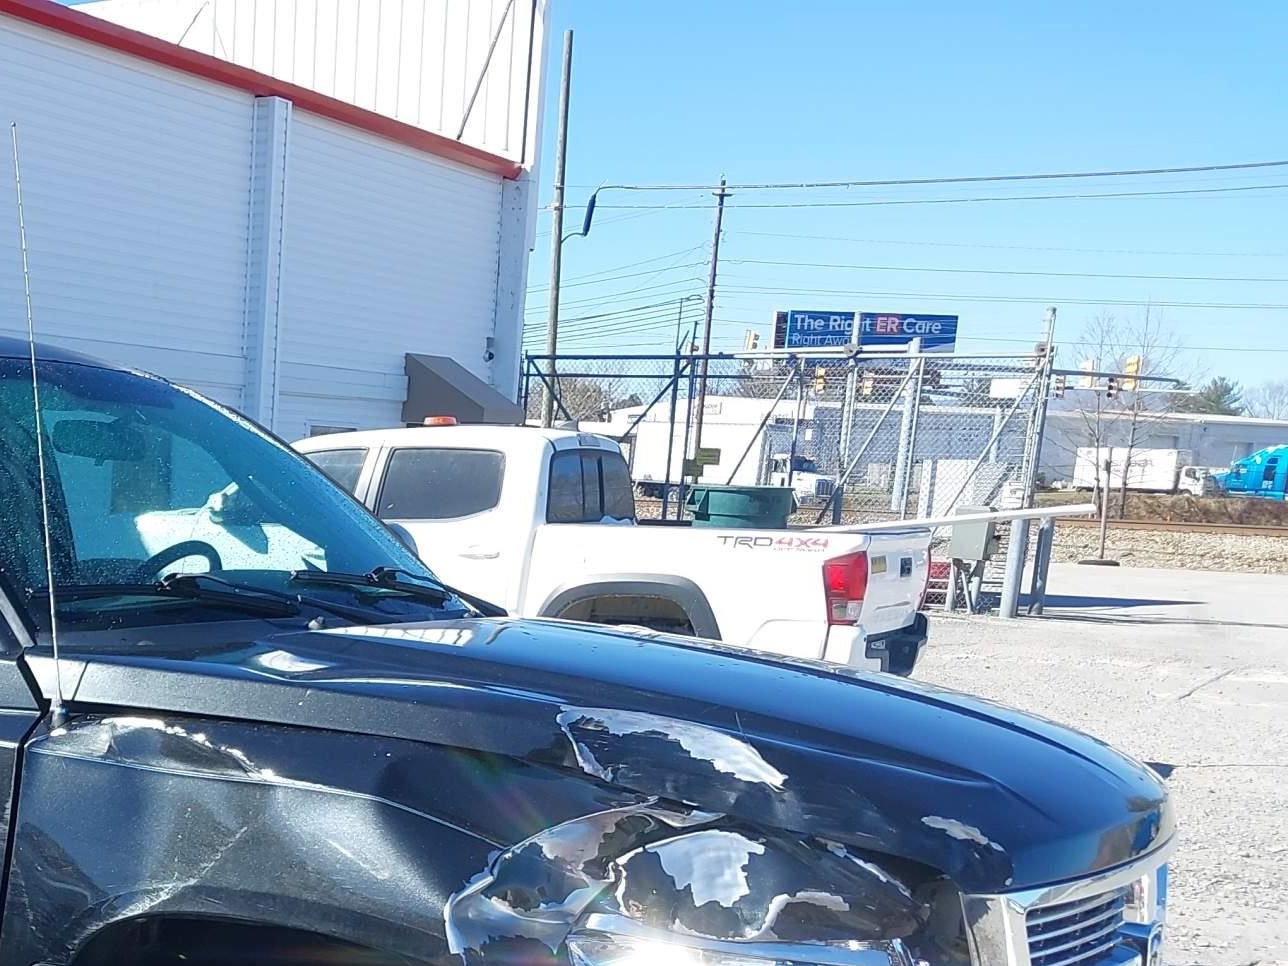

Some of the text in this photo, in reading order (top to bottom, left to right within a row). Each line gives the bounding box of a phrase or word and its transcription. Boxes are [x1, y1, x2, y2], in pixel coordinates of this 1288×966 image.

[794, 314, 825, 330] The
[875, 316, 899, 333] ER
[902, 318, 942, 335] Care
[792, 332, 850, 346] Right Awa
[717, 535, 773, 549] TRD
